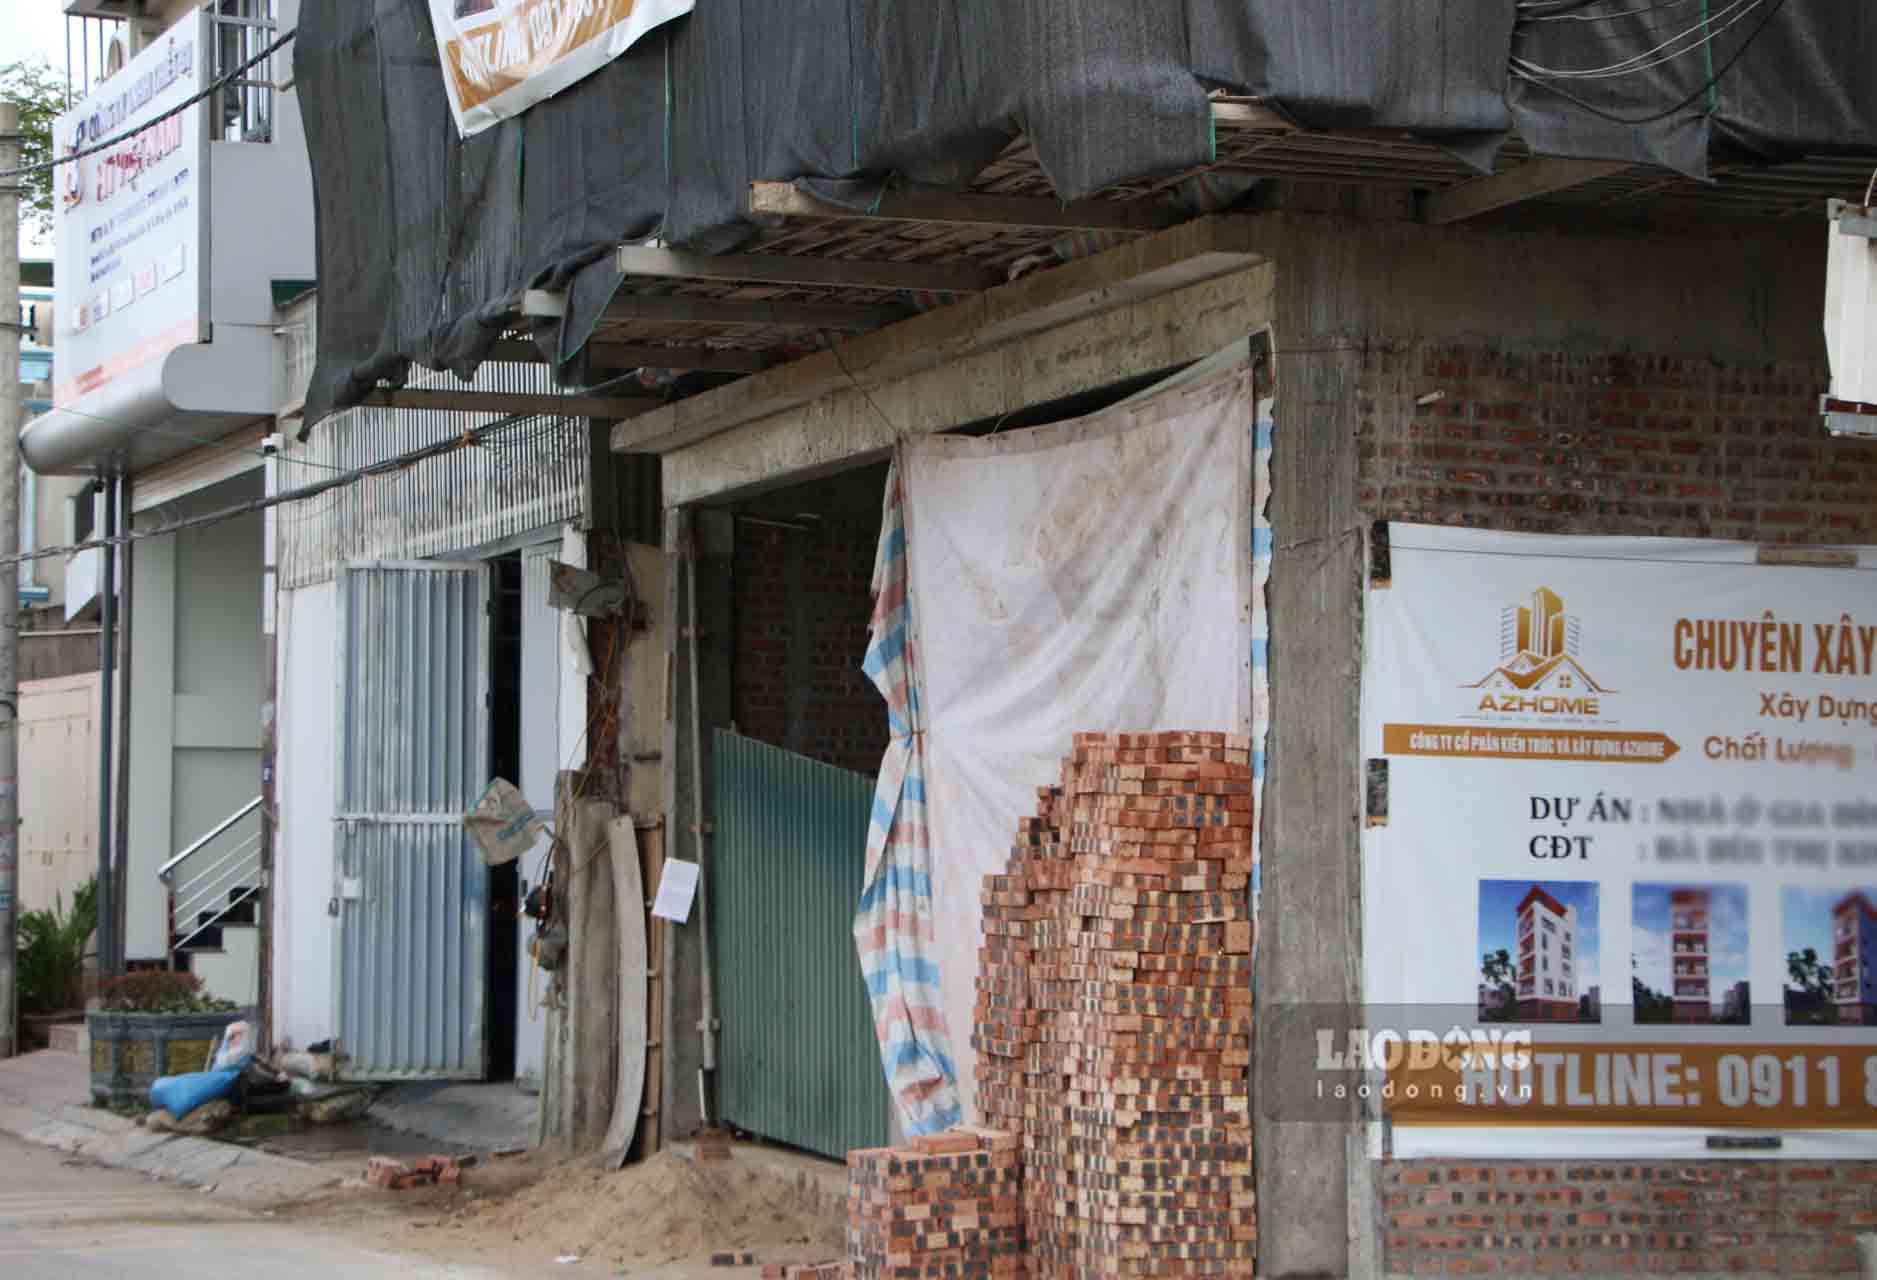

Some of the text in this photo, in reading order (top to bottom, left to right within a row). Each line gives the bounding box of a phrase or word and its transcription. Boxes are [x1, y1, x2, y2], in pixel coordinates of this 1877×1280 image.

[1673, 609, 1877, 675] CHUYÊN XÂY
[1479, 694, 1599, 716] AZHOME
[1760, 691, 1809, 722] Xây
[1704, 730, 1768, 760] Chất
[1529, 796, 1580, 827] DỰ
[1588, 791, 1632, 823] ÁN
[1529, 835, 1593, 859] CĐT
[1461, 1053, 1701, 1107] HOTLINE:
[1717, 1054, 1841, 1108] 0911
